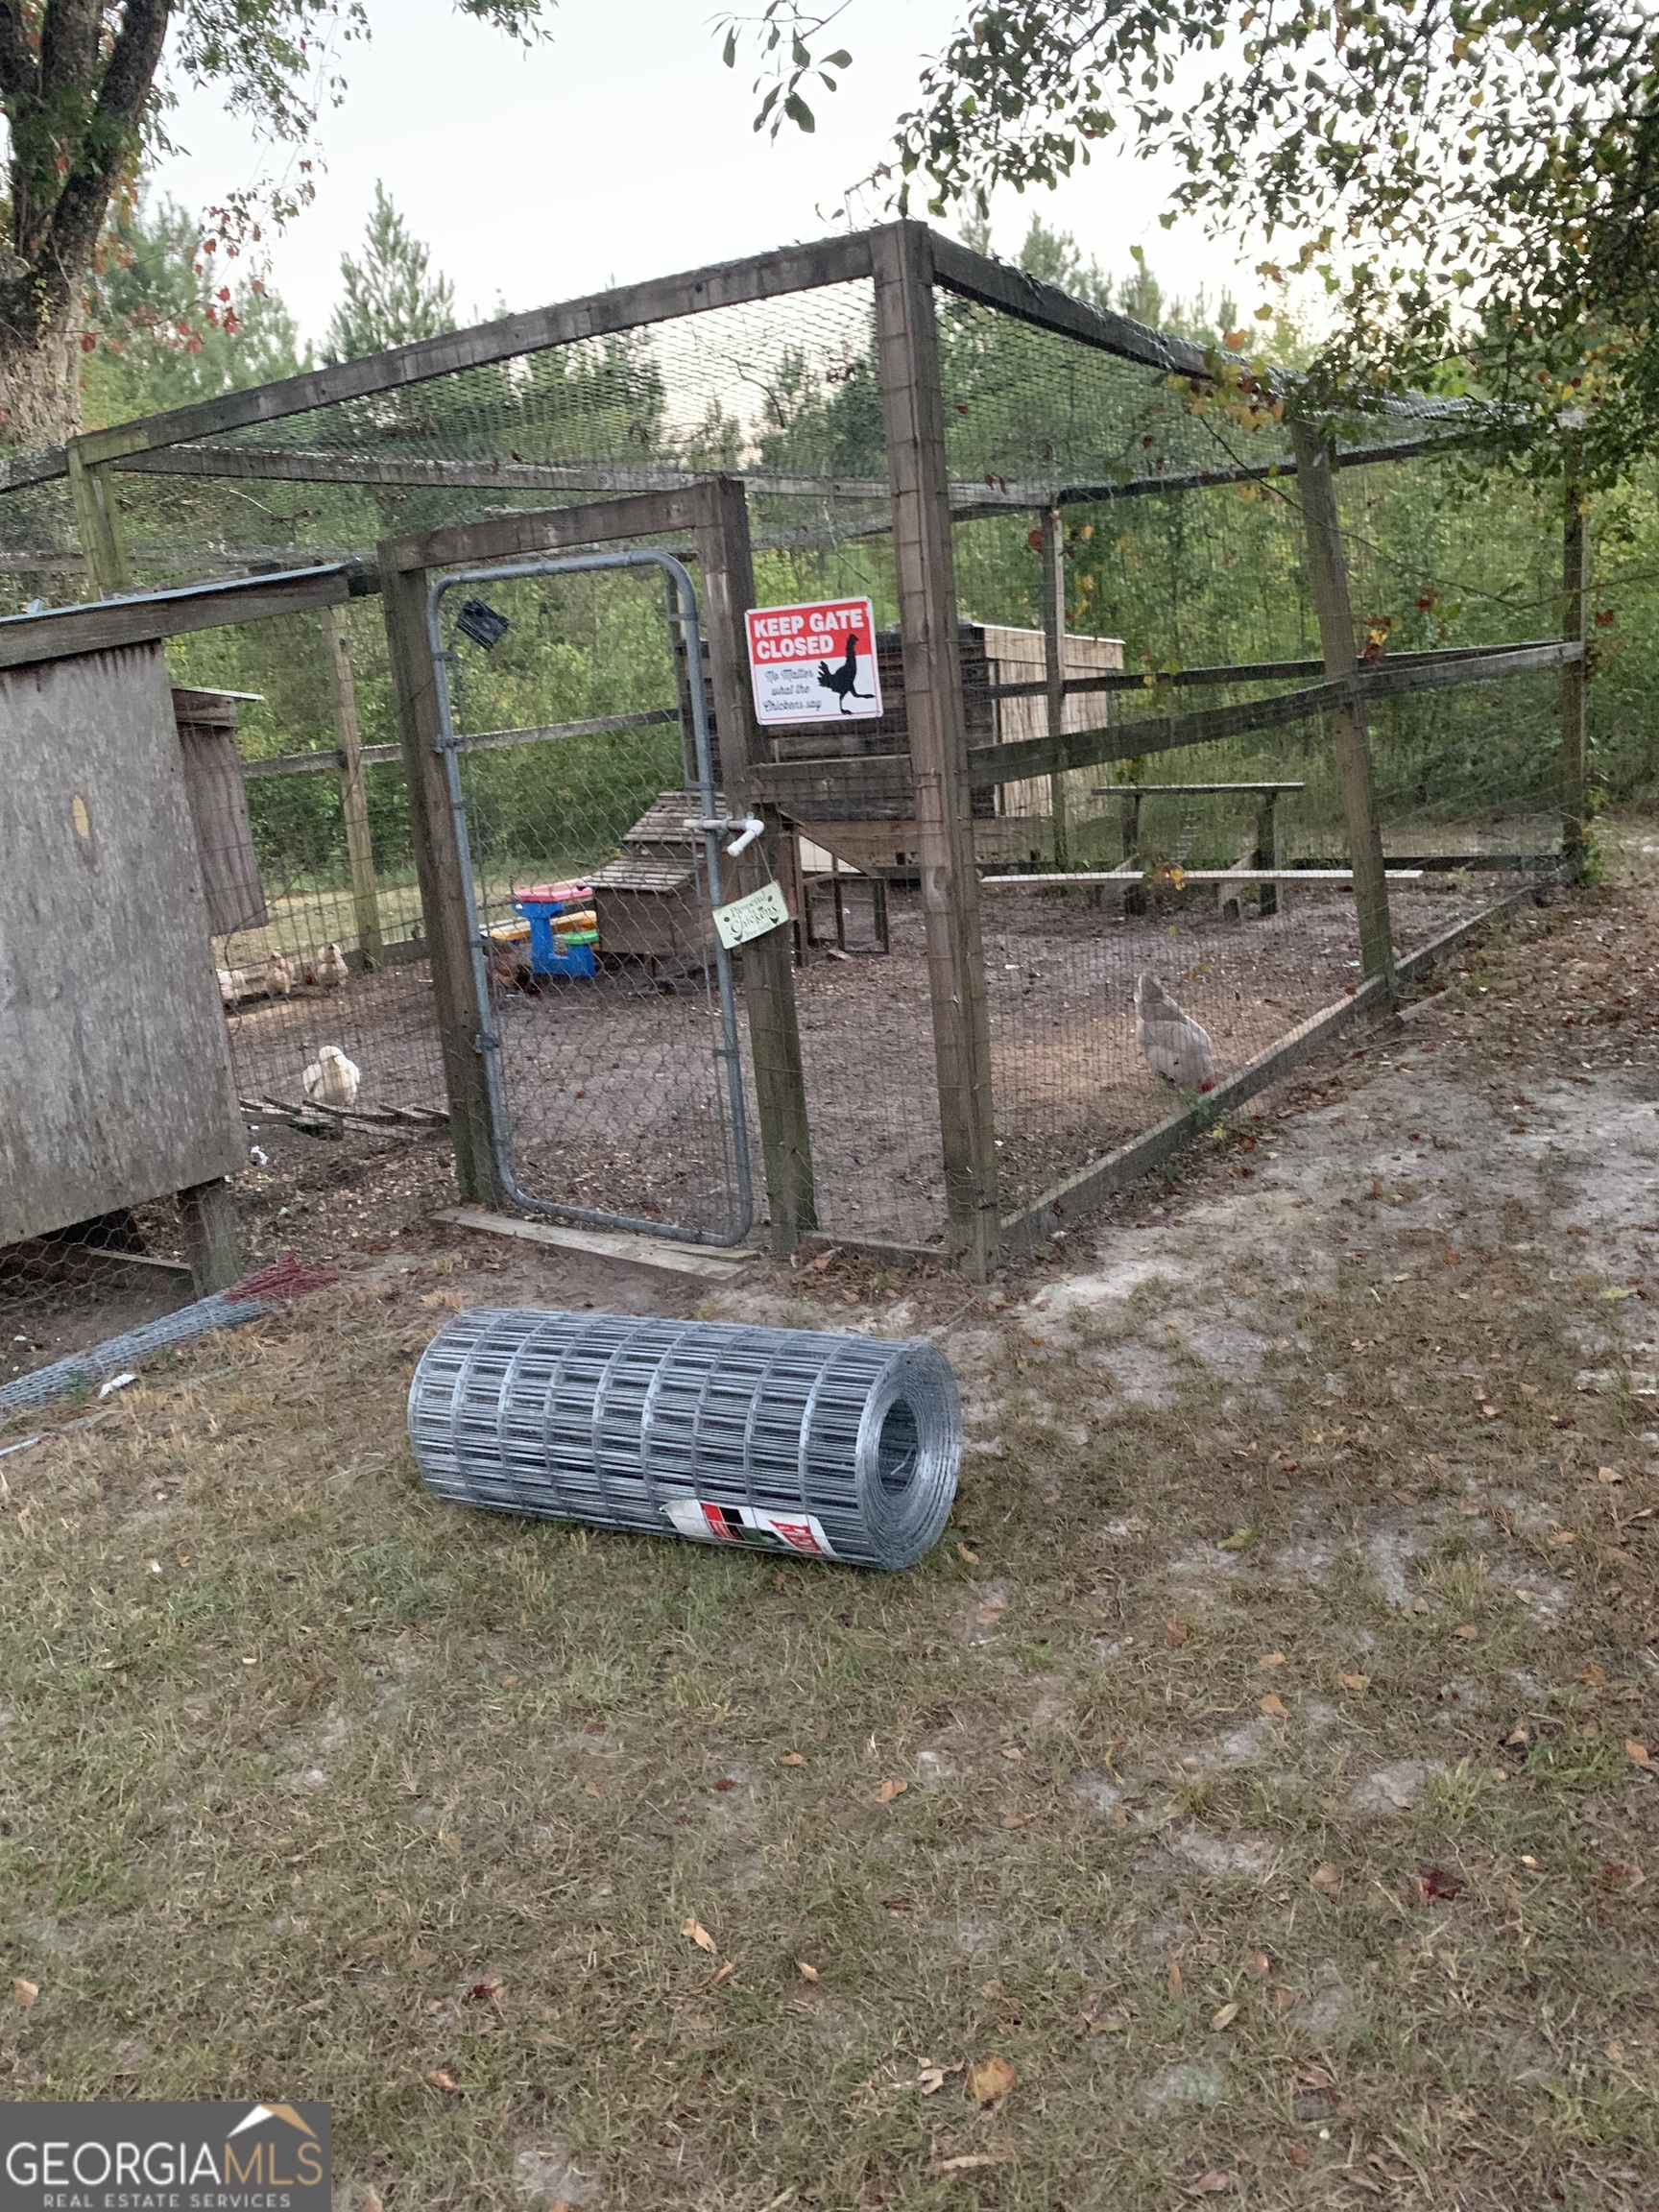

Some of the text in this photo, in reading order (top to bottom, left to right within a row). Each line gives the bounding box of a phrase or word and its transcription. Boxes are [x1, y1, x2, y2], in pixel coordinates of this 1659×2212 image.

[754, 609, 863, 637] KEEP GATE
[757, 635, 833, 660] CLOSED
